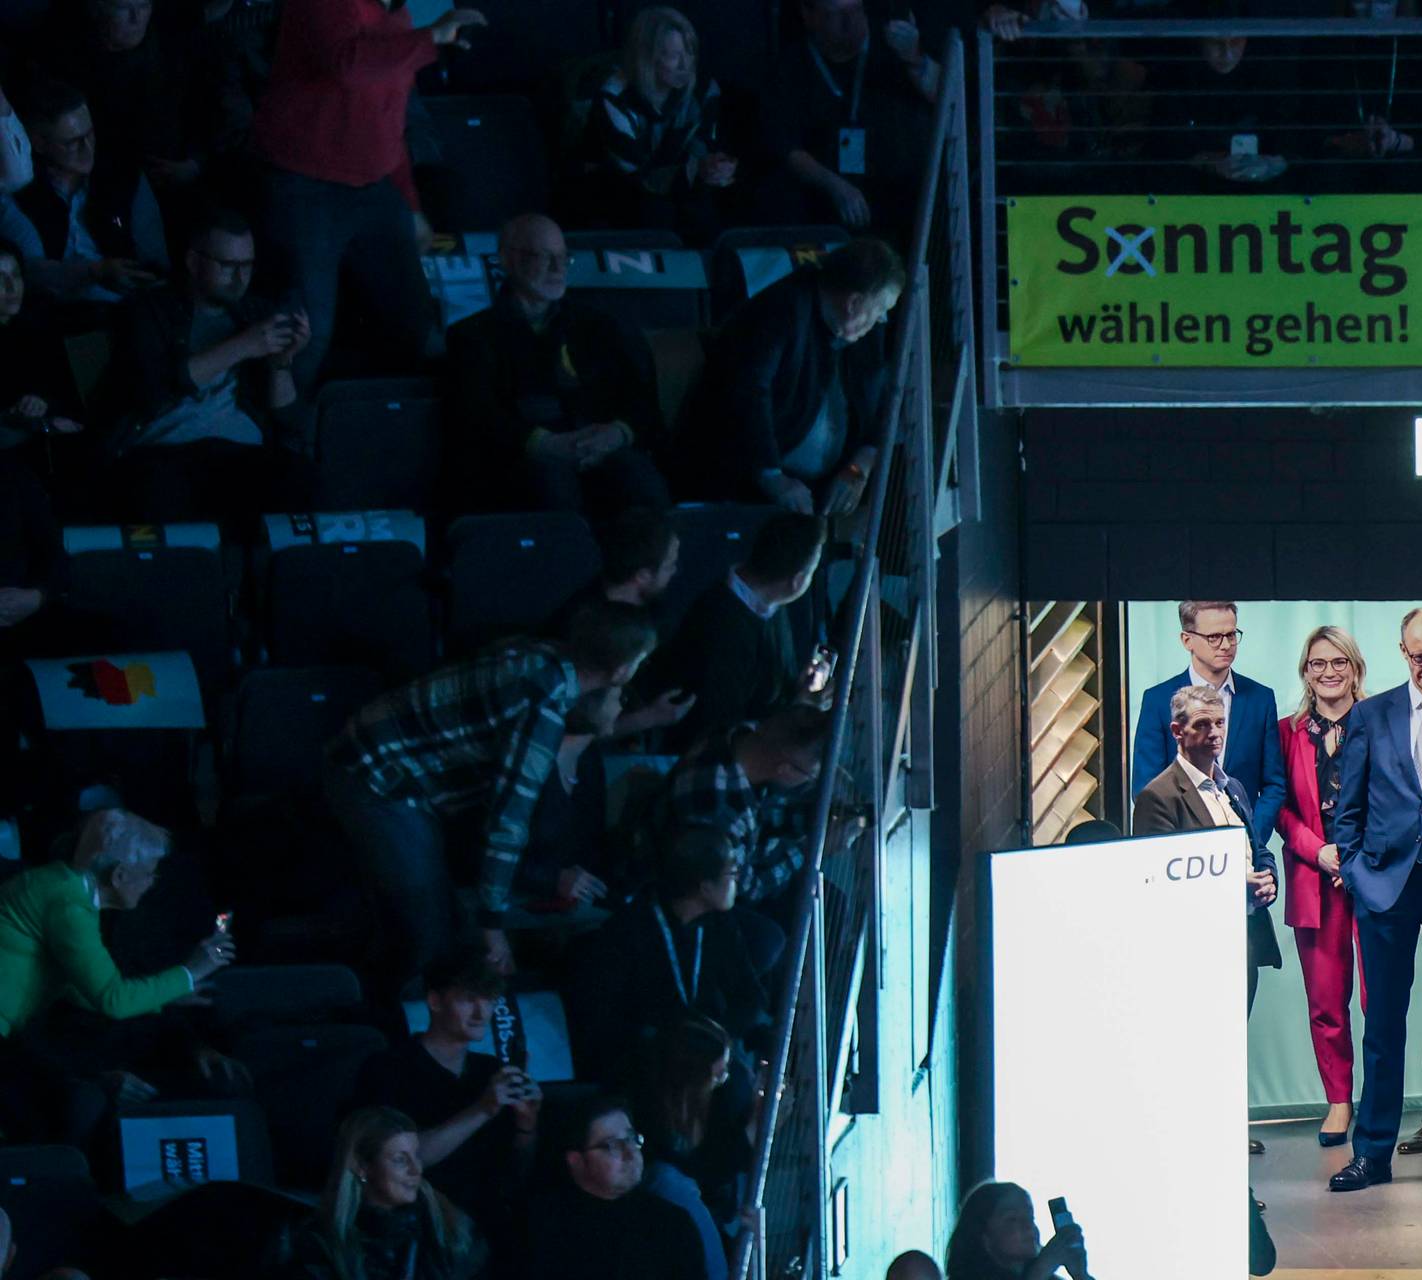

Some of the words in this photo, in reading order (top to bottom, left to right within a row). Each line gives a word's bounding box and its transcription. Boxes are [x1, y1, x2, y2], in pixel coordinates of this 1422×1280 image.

[1056, 205, 1409, 297] Sonntag
[1056, 302, 1231, 344] wählen
[1246, 302, 1410, 356] gehen!
[1166, 852, 1228, 881] CDU
